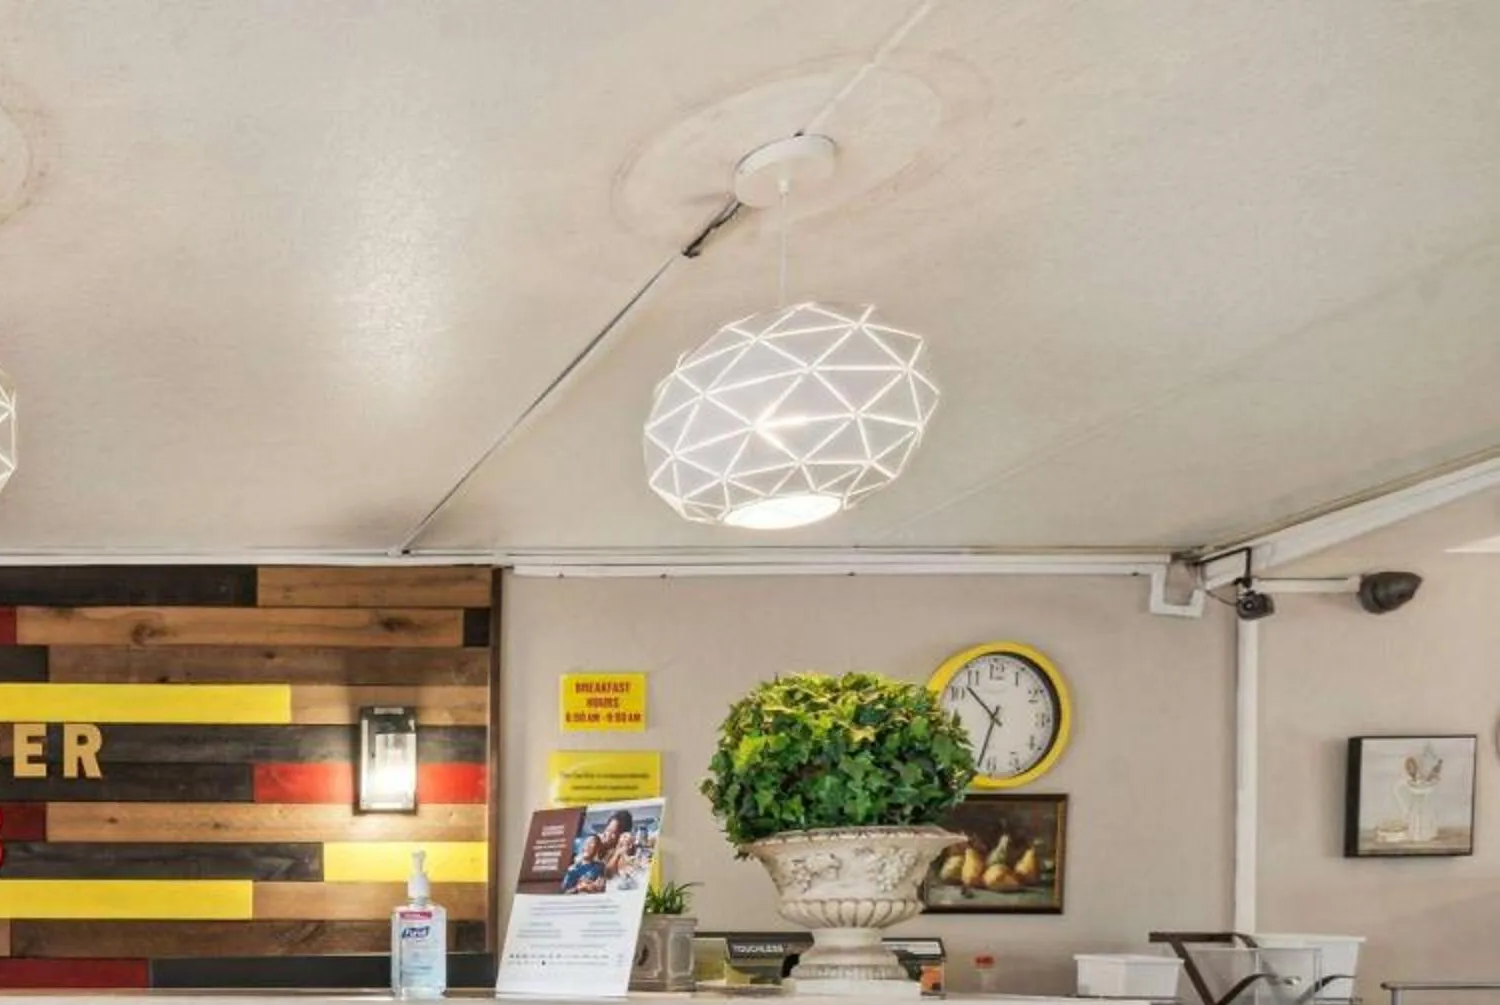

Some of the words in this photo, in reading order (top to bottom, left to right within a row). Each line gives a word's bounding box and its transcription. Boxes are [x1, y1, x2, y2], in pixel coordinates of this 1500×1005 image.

[966, 669, 981, 686] 11
[988, 662, 1006, 681] 12
[1014, 671, 1020, 687] 1
[574, 682, 630, 693] BREAKFAST
[951, 686, 966, 700] 10
[1027, 684, 1040, 703] 2
[586, 697, 619, 708] HOURS
